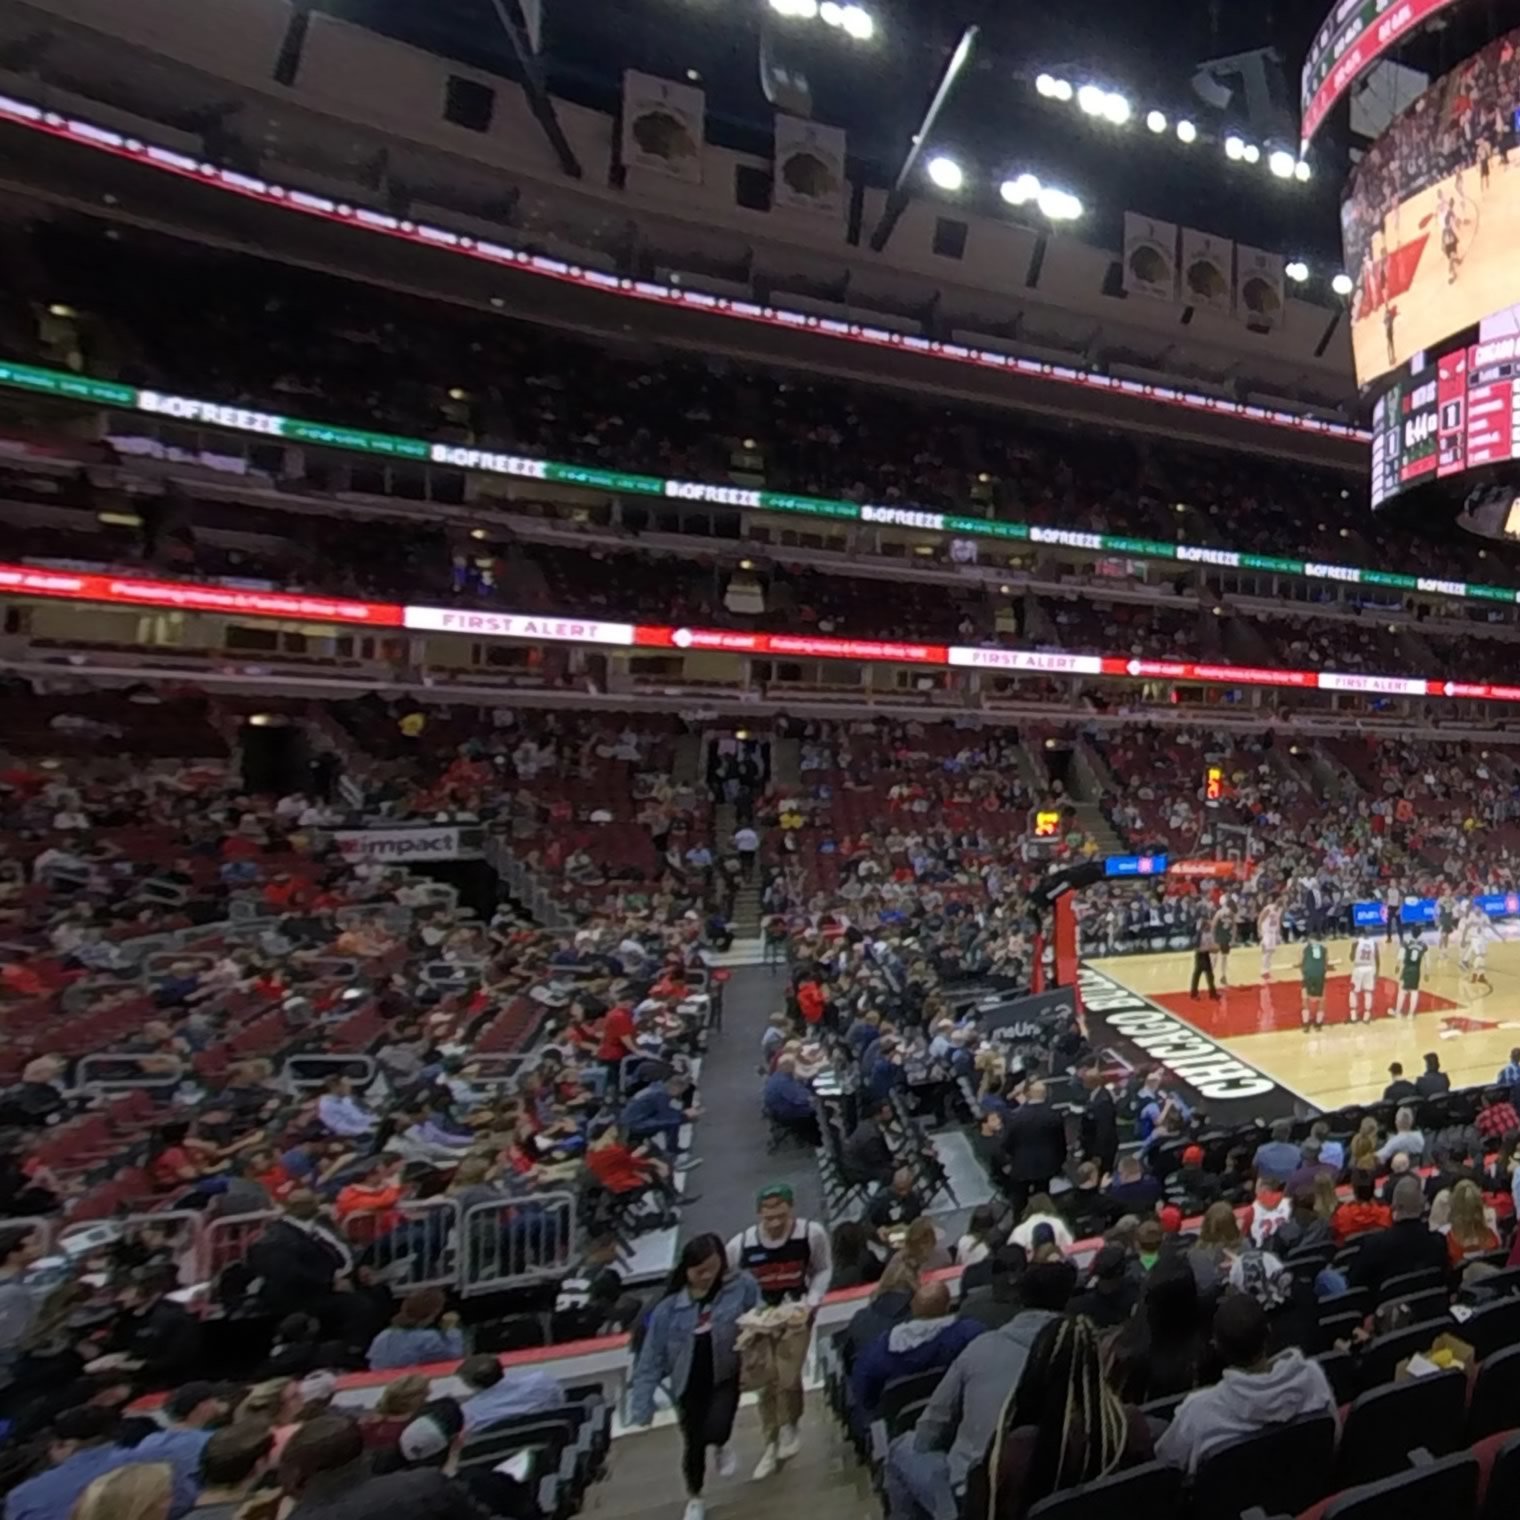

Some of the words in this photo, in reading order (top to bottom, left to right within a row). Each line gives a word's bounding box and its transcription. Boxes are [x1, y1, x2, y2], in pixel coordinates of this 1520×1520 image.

[442, 613, 513, 632] FIRST
[524, 617, 599, 639] ALERT
[972, 652, 1019, 666] FIRST
[1024, 656, 1077, 669] ALERT
[1334, 677, 1368, 689] FIRST
[1371, 679, 1409, 691] ALERT
[1106, 1010, 1276, 1099] CHICAGO
